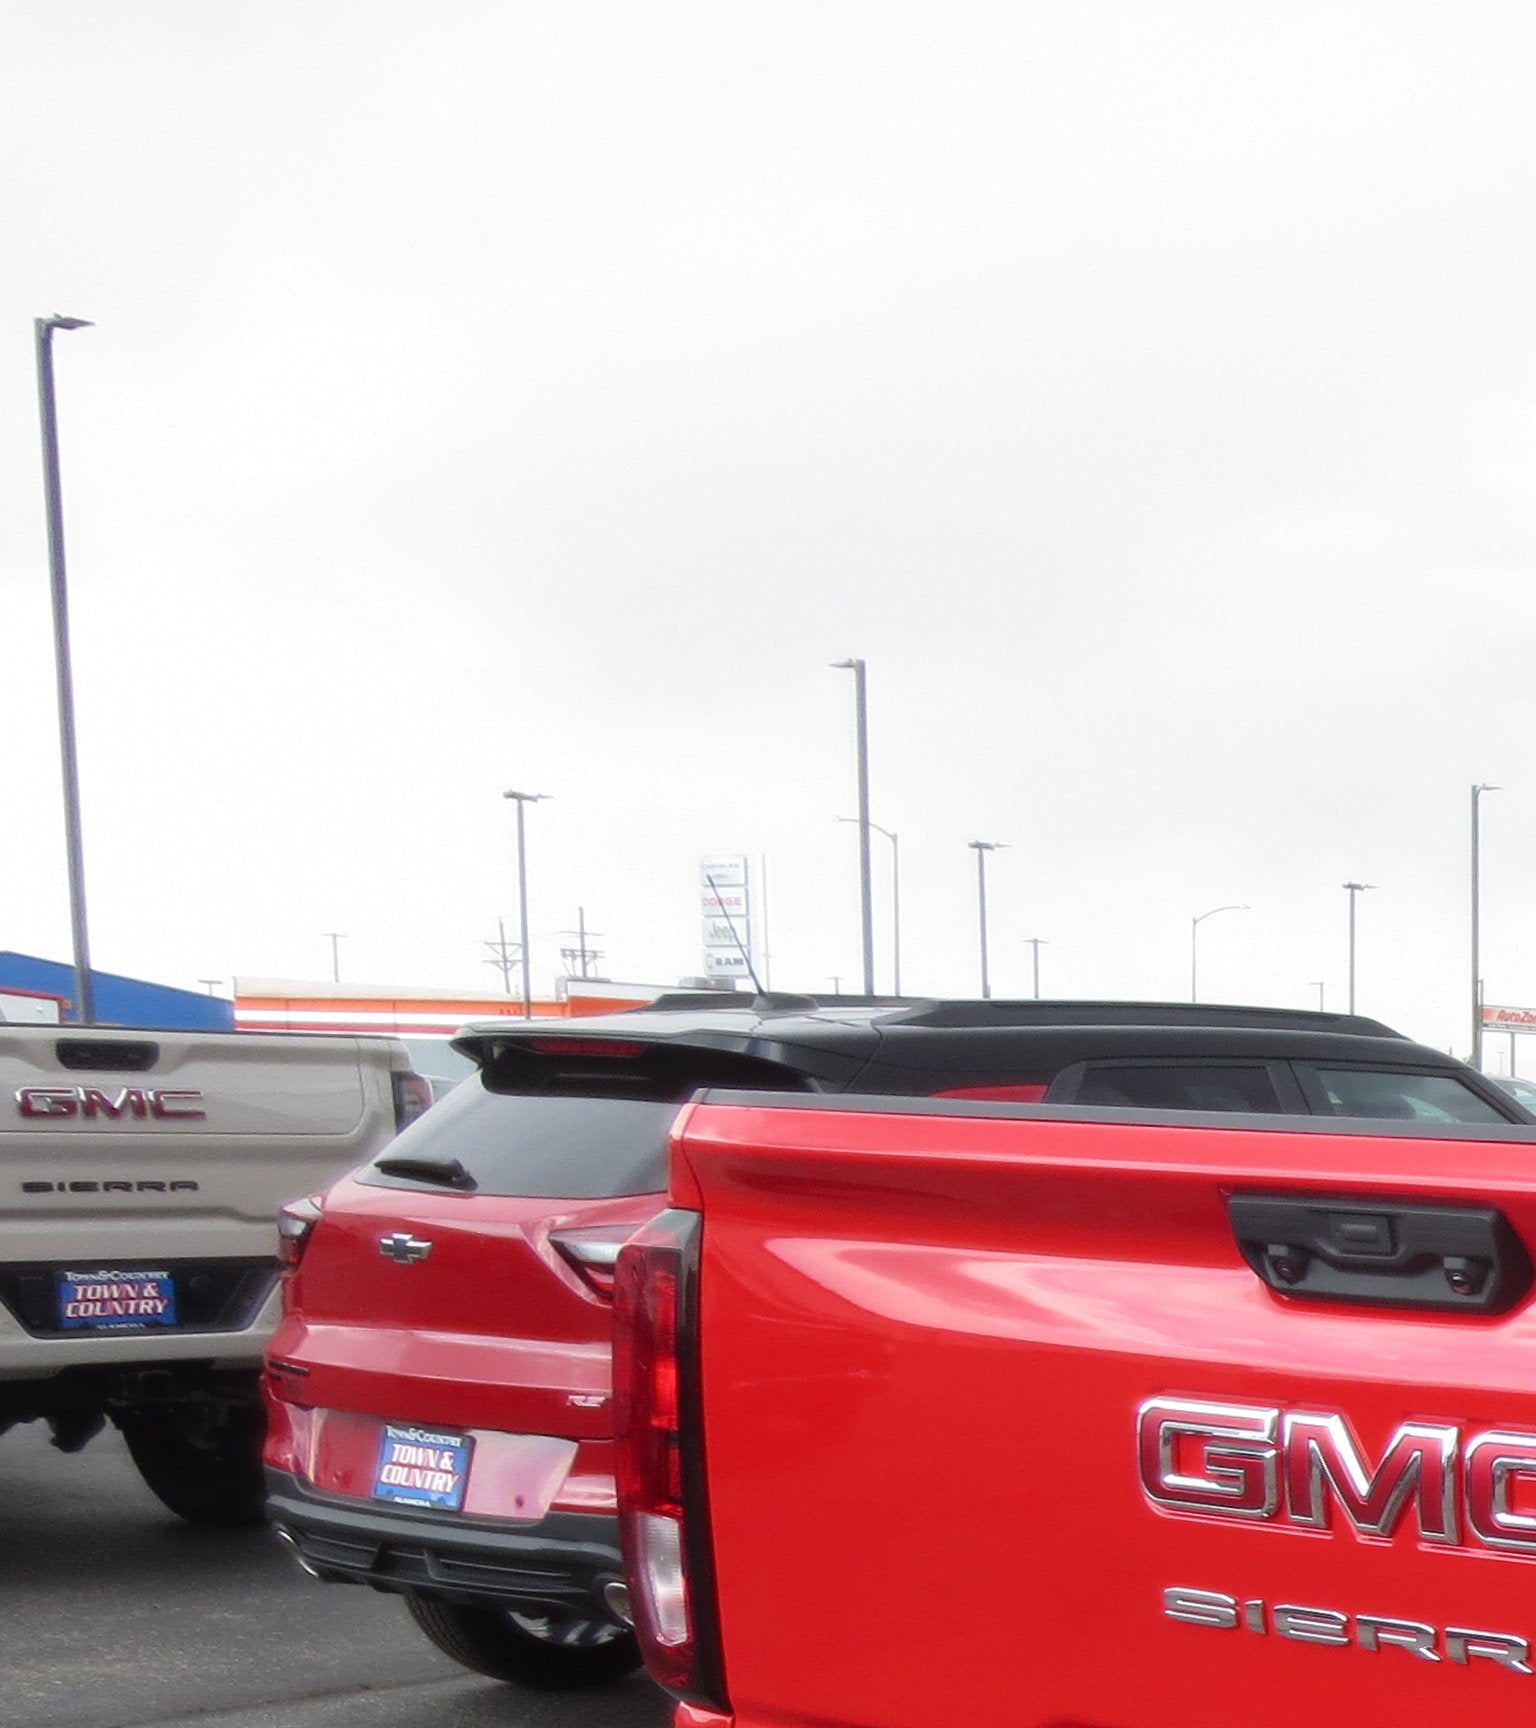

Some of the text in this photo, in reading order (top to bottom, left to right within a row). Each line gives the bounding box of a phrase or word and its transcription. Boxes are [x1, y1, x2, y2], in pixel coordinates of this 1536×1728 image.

[15, 1086, 206, 1120] GMC
[22, 1181, 199, 1193] SIERRA
[74, 1282, 159, 1300] TOWN &
[65, 1299, 169, 1318] COUNTRY
[391, 1443, 455, 1471] TOWN &
[380, 1464, 460, 1493] COUNTRY
